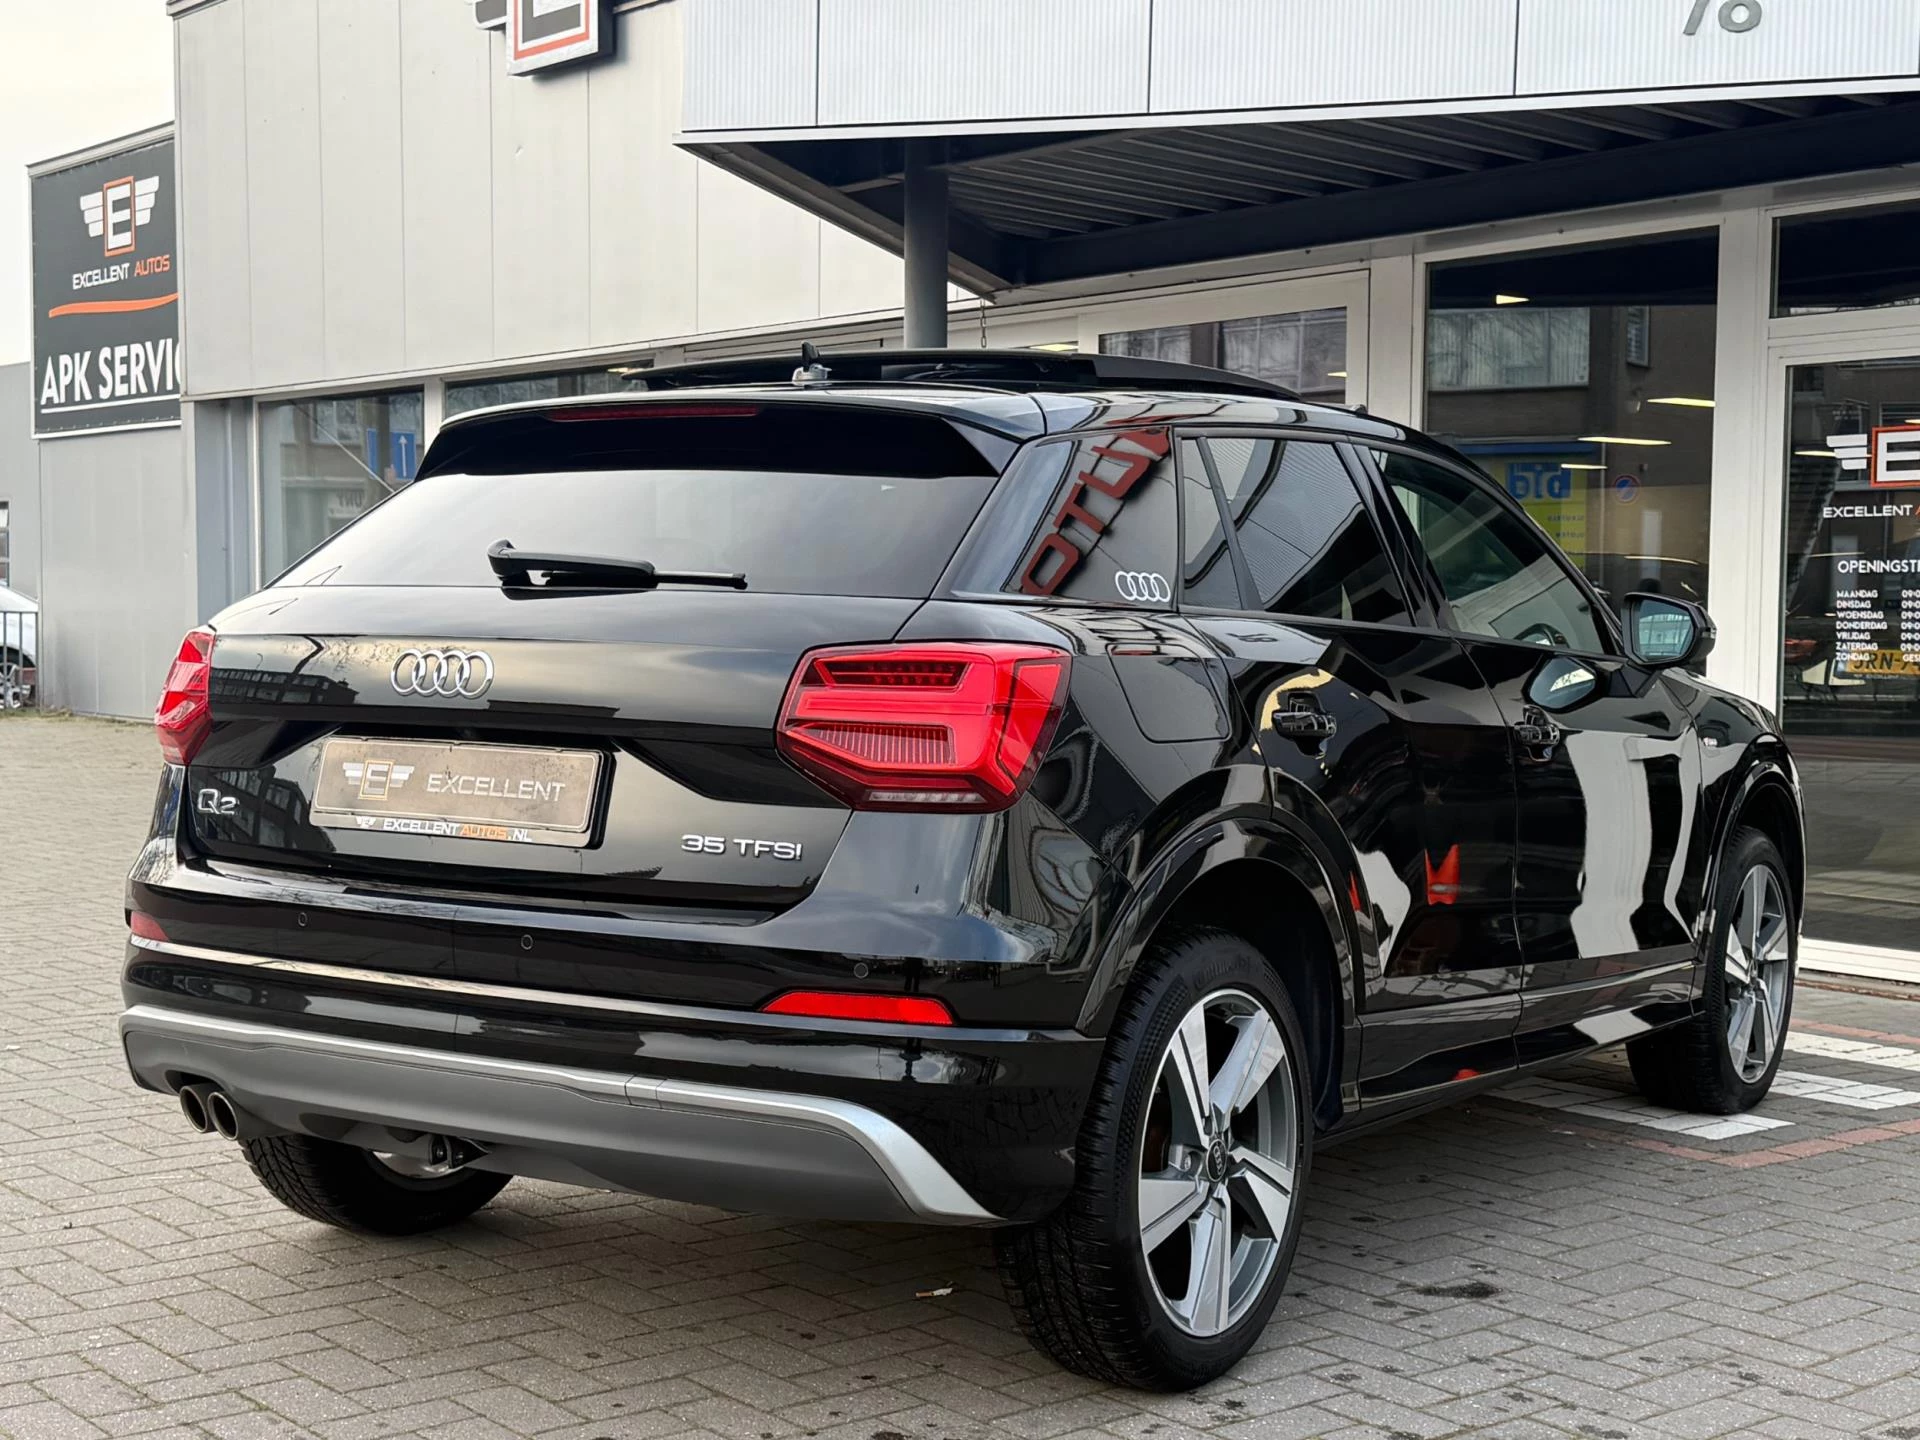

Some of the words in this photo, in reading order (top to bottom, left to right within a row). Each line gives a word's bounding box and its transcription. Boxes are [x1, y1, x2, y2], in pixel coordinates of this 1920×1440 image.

[72, 262, 131, 290] EXCELLENT
[134, 254, 170, 277] AUTOS
[40, 350, 93, 406] APK
[1822, 504, 1914, 519] EXCELLENT
[1836, 589, 1878, 599] MAANDAG
[1837, 610, 1884, 619] WOENSDAG
[1836, 621, 1888, 630] DONDERDAG
[1836, 631, 1871, 640] VRIJDAG
[1836, 641, 1878, 651] ZATERDAG
[1836, 652, 1870, 661] ZONDAG
[426, 773, 566, 802] EXCELLENT
[197, 788, 238, 815] Q2
[681, 833, 726, 854] 35
[732, 838, 803, 861] TFSI
